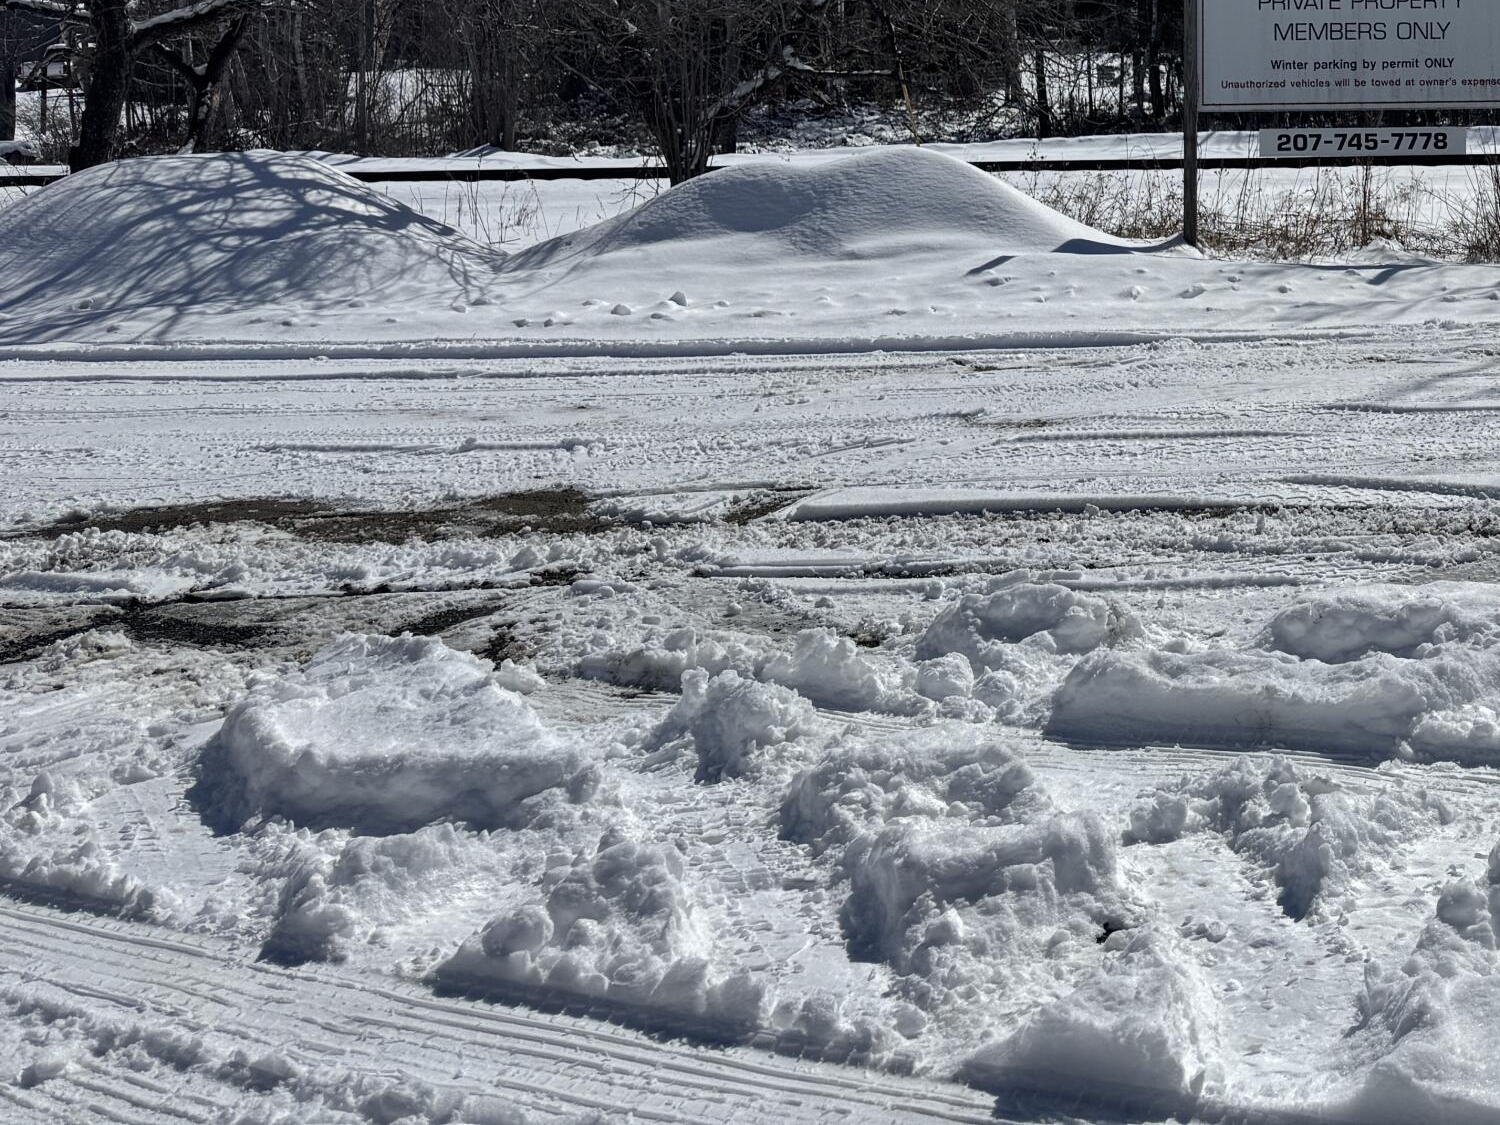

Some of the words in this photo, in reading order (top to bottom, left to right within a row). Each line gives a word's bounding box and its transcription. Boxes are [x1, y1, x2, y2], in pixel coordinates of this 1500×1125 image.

[1274, 23, 1387, 41] MEMBERS
[1396, 22, 1451, 40] ONLY
[1271, 59, 1307, 70] Winter
[1314, 59, 1357, 71] parking
[1363, 59, 1376, 70] by
[1382, 58, 1419, 70] permit
[1425, 58, 1455, 68] ONLY
[1221, 79, 1286, 89] Unauthorized
[1290, 79, 1330, 88] vehicles
[1335, 78, 1350, 87] will
[1354, 79, 1367, 87] be
[1371, 78, 1401, 87] towed
[1405, 78, 1415, 86] at
[1419, 77, 1457, 86] owner's
[1277, 132, 1448, 151] 207-745-7778
